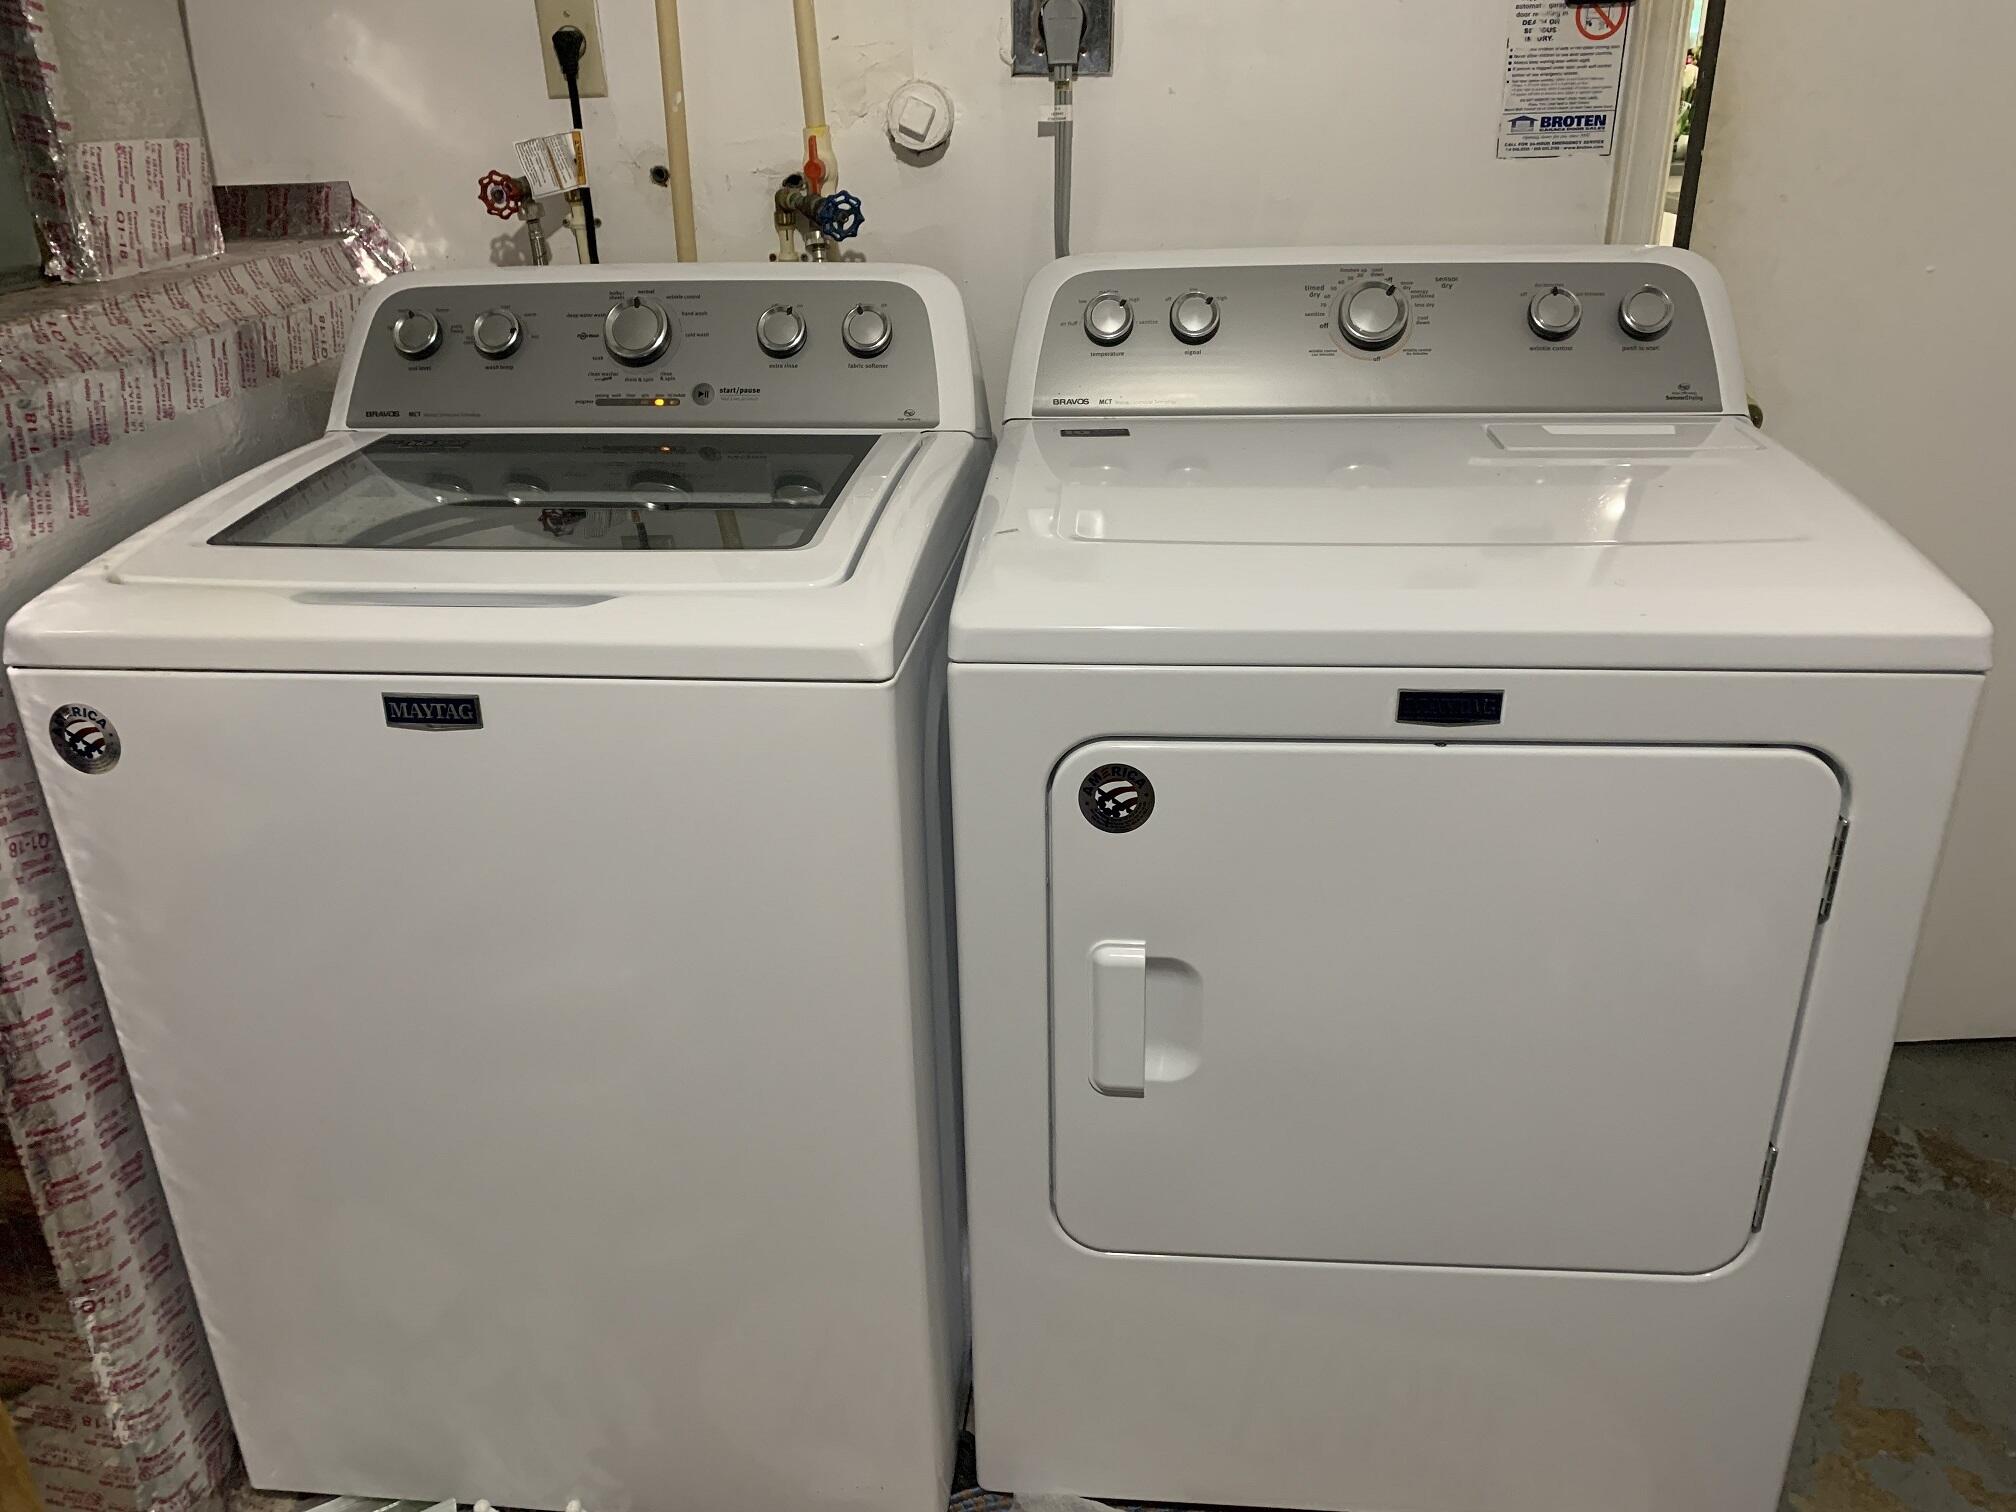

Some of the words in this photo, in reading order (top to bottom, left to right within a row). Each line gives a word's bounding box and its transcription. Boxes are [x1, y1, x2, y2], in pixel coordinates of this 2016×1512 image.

[1540, 114, 1607, 128] BROTEN
[719, 386, 761, 395] start/pause
[388, 702, 474, 720] MAYTAG
[1083, 766, 1147, 797] AMERICA
